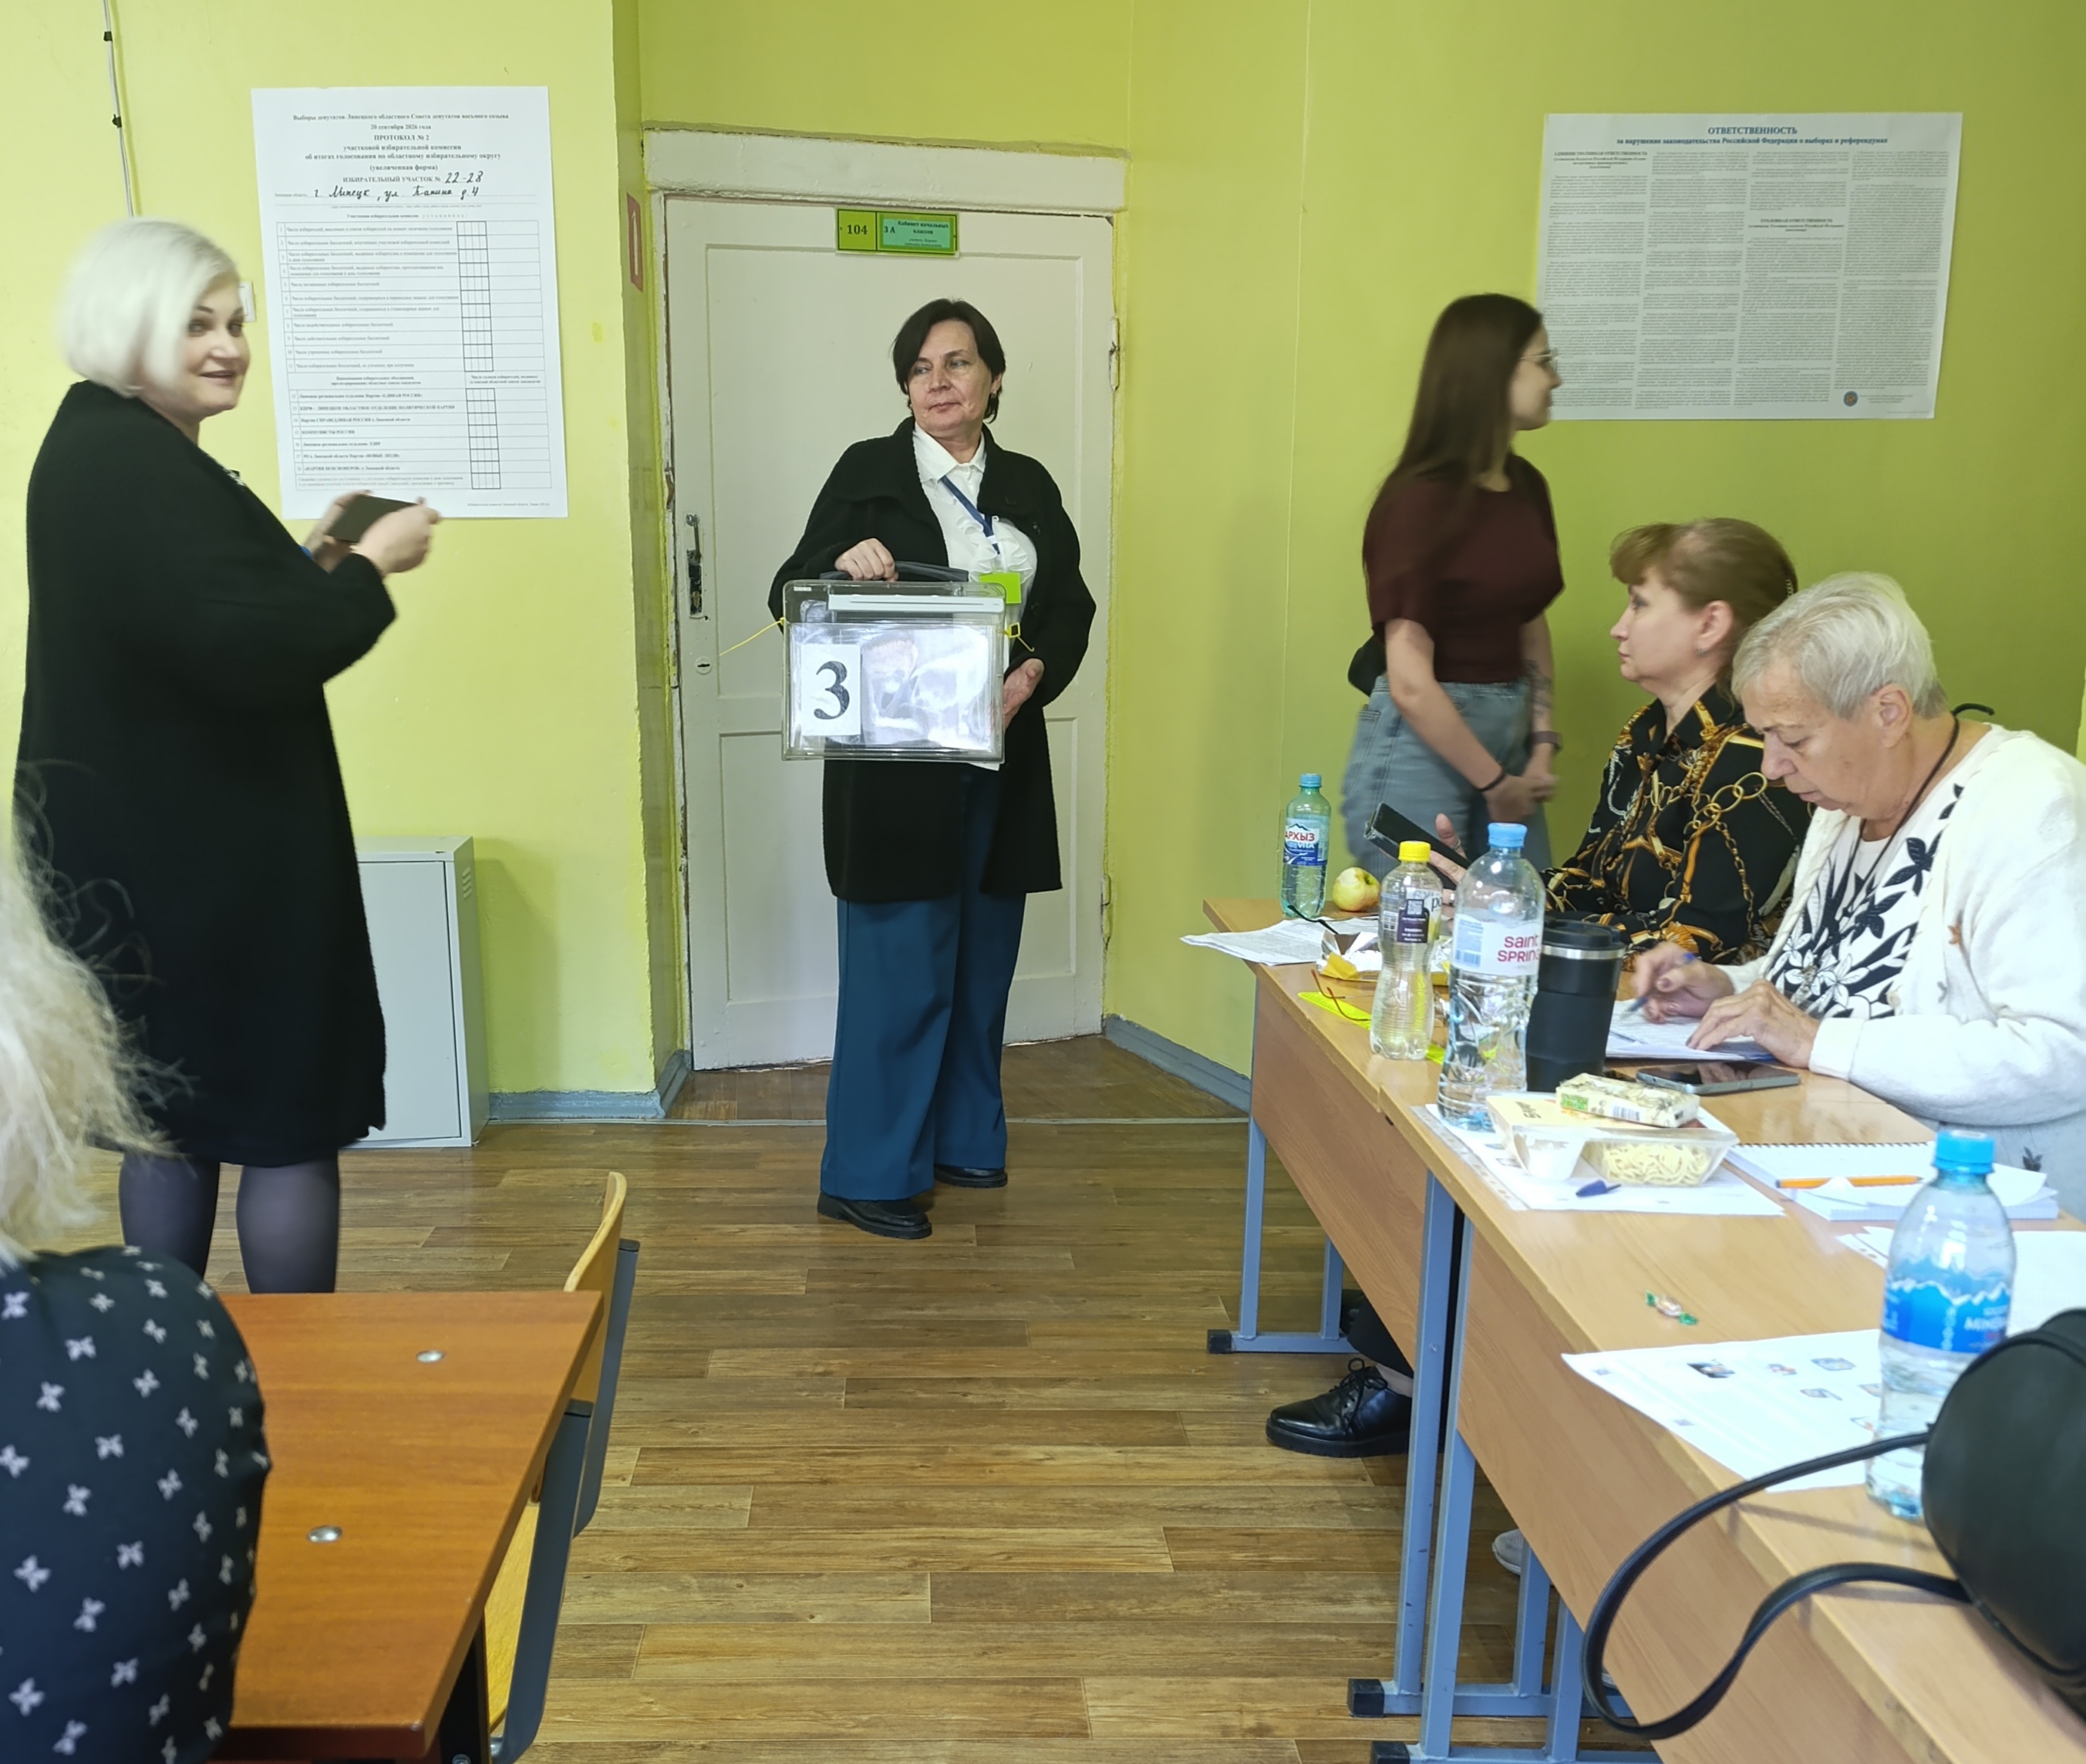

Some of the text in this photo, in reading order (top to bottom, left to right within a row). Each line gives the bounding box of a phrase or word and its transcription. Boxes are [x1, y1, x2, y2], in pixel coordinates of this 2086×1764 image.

[1707, 126, 1798, 135] ОТВЕТСТВЕННОСТЬ
[445, 170, 484, 183] 22-28
[471, 186, 479, 197] 4
[847, 224, 868, 235] 104
[814, 660, 851, 720] 3
